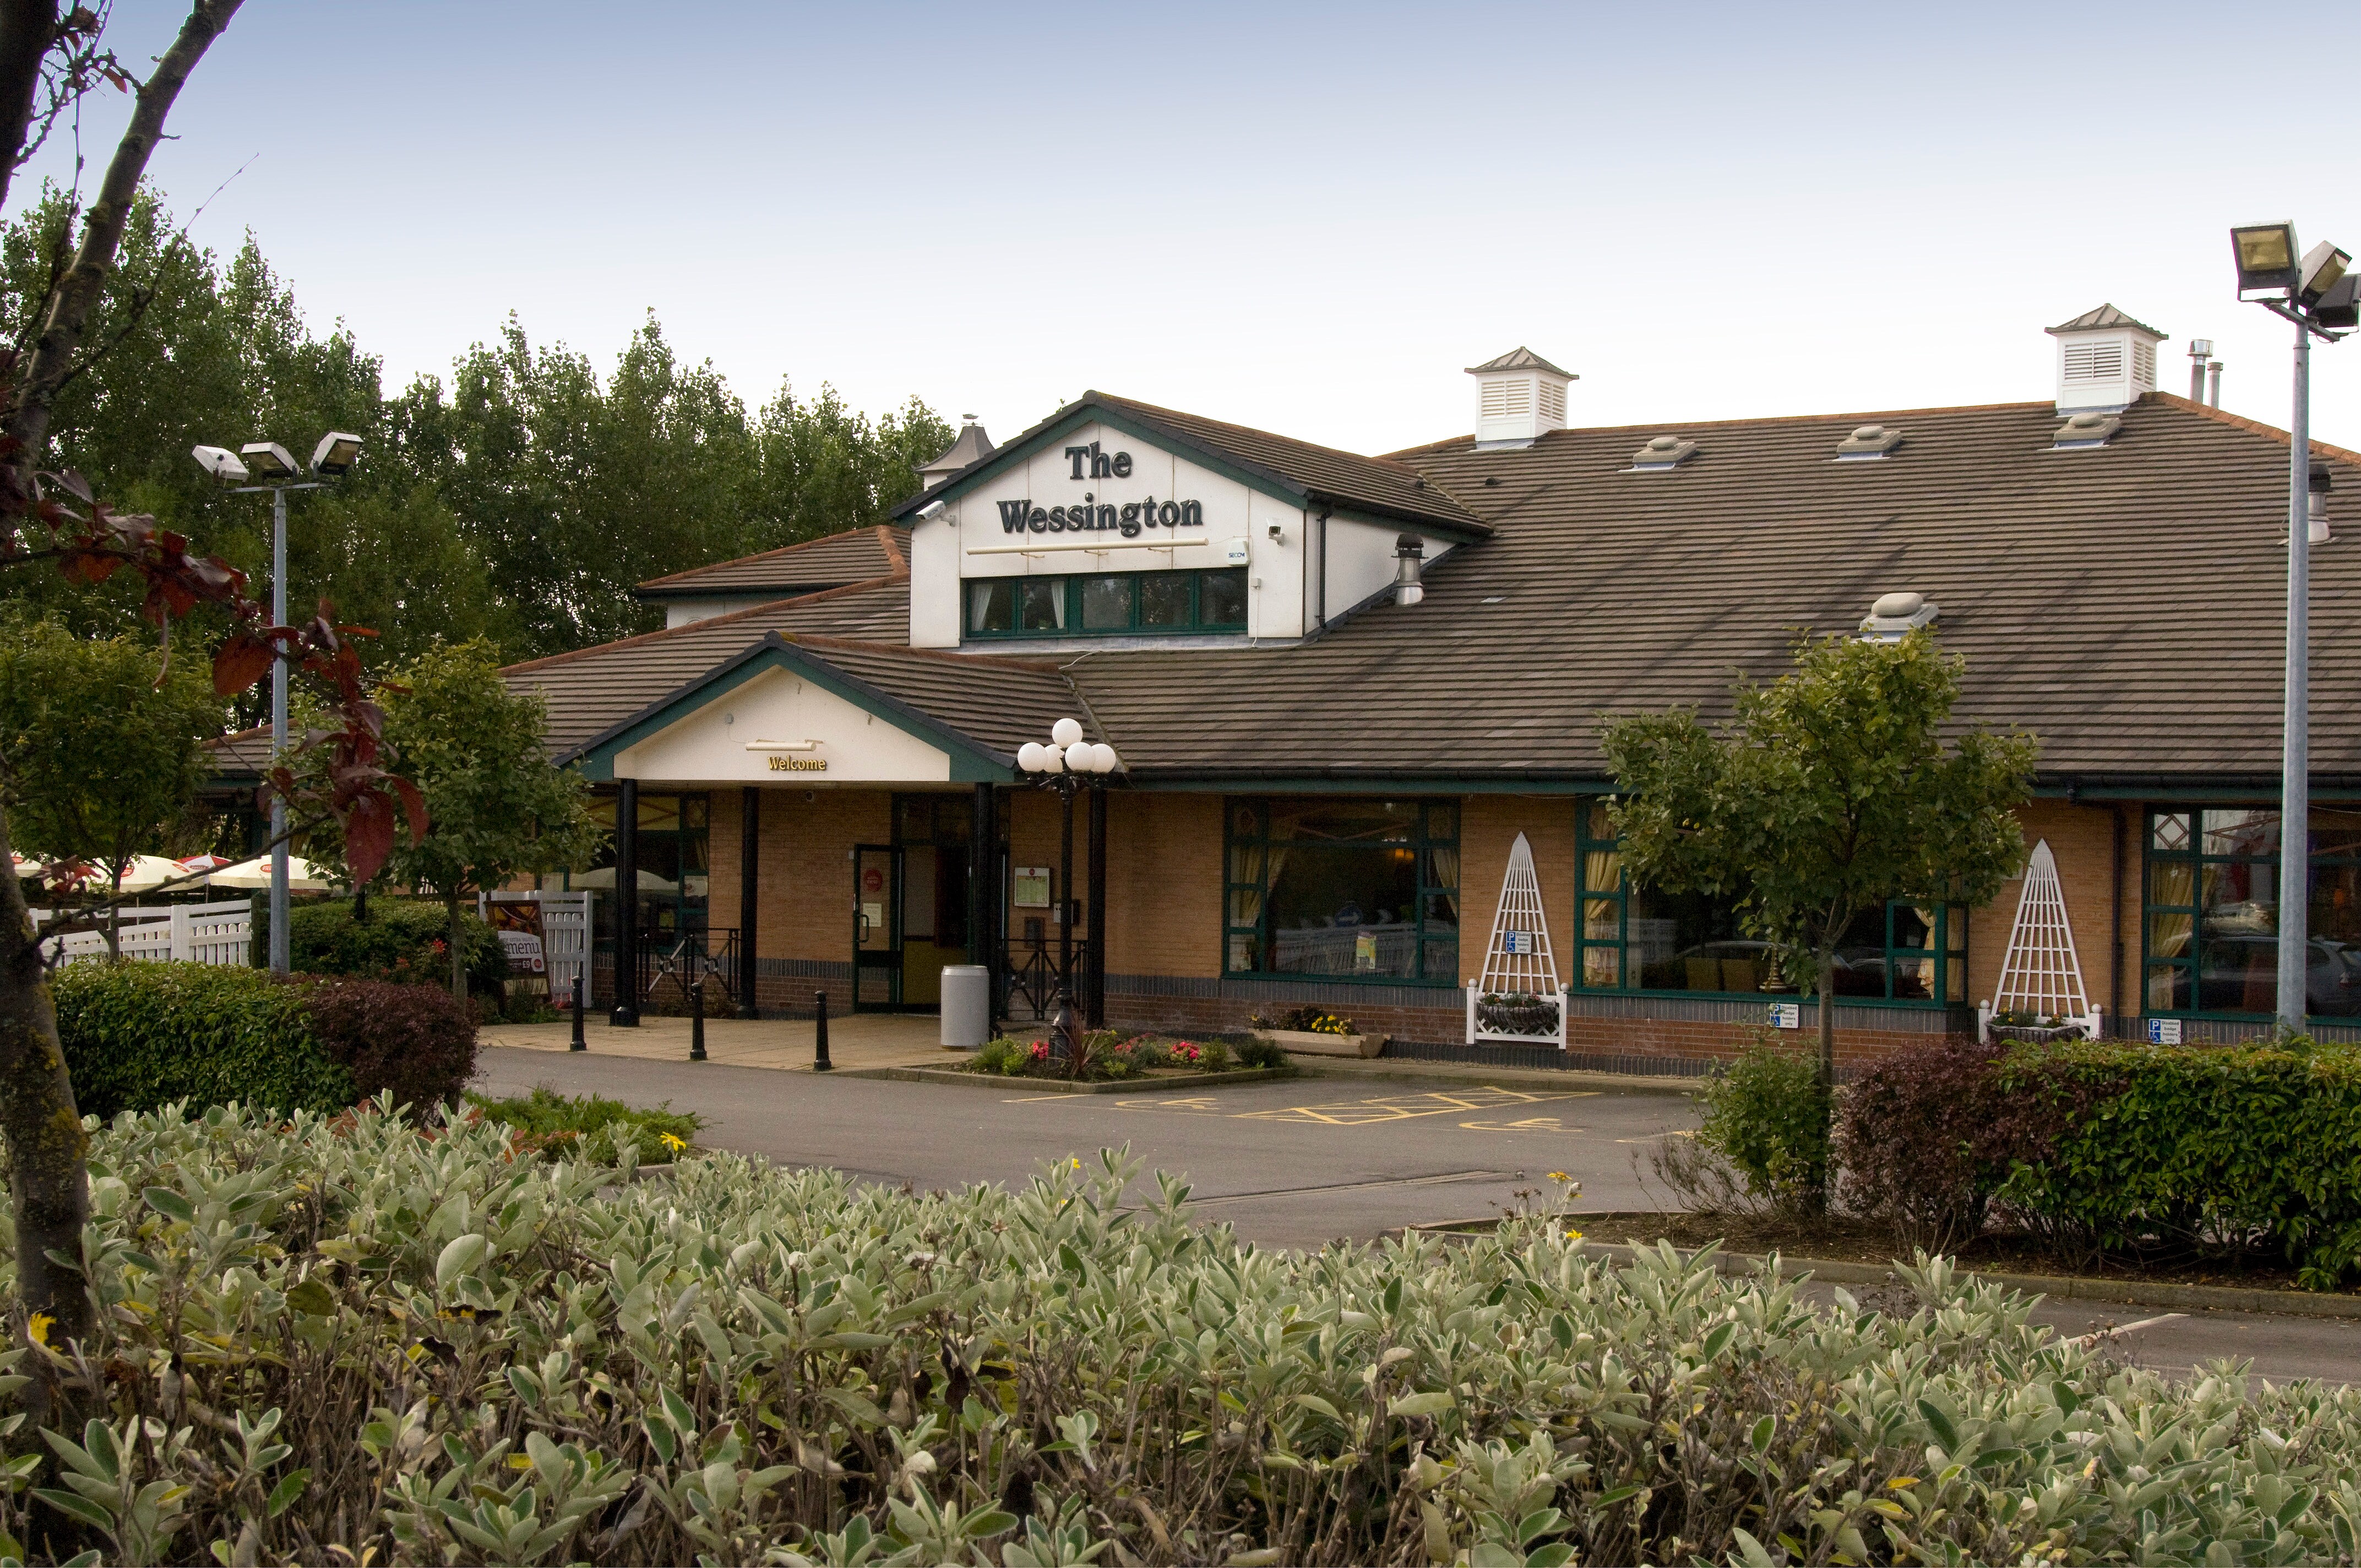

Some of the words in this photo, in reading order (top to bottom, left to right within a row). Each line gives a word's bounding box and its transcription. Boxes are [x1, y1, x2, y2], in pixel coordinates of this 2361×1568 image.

[1065, 440, 1132, 480] The
[997, 492, 1203, 537] Wessington
[768, 755, 826, 770] Welcome
[1509, 933, 1514, 941] P
[507, 943, 541, 954] menu
[523, 960, 530, 968] £9
[2152, 1021, 2159, 1030] P
